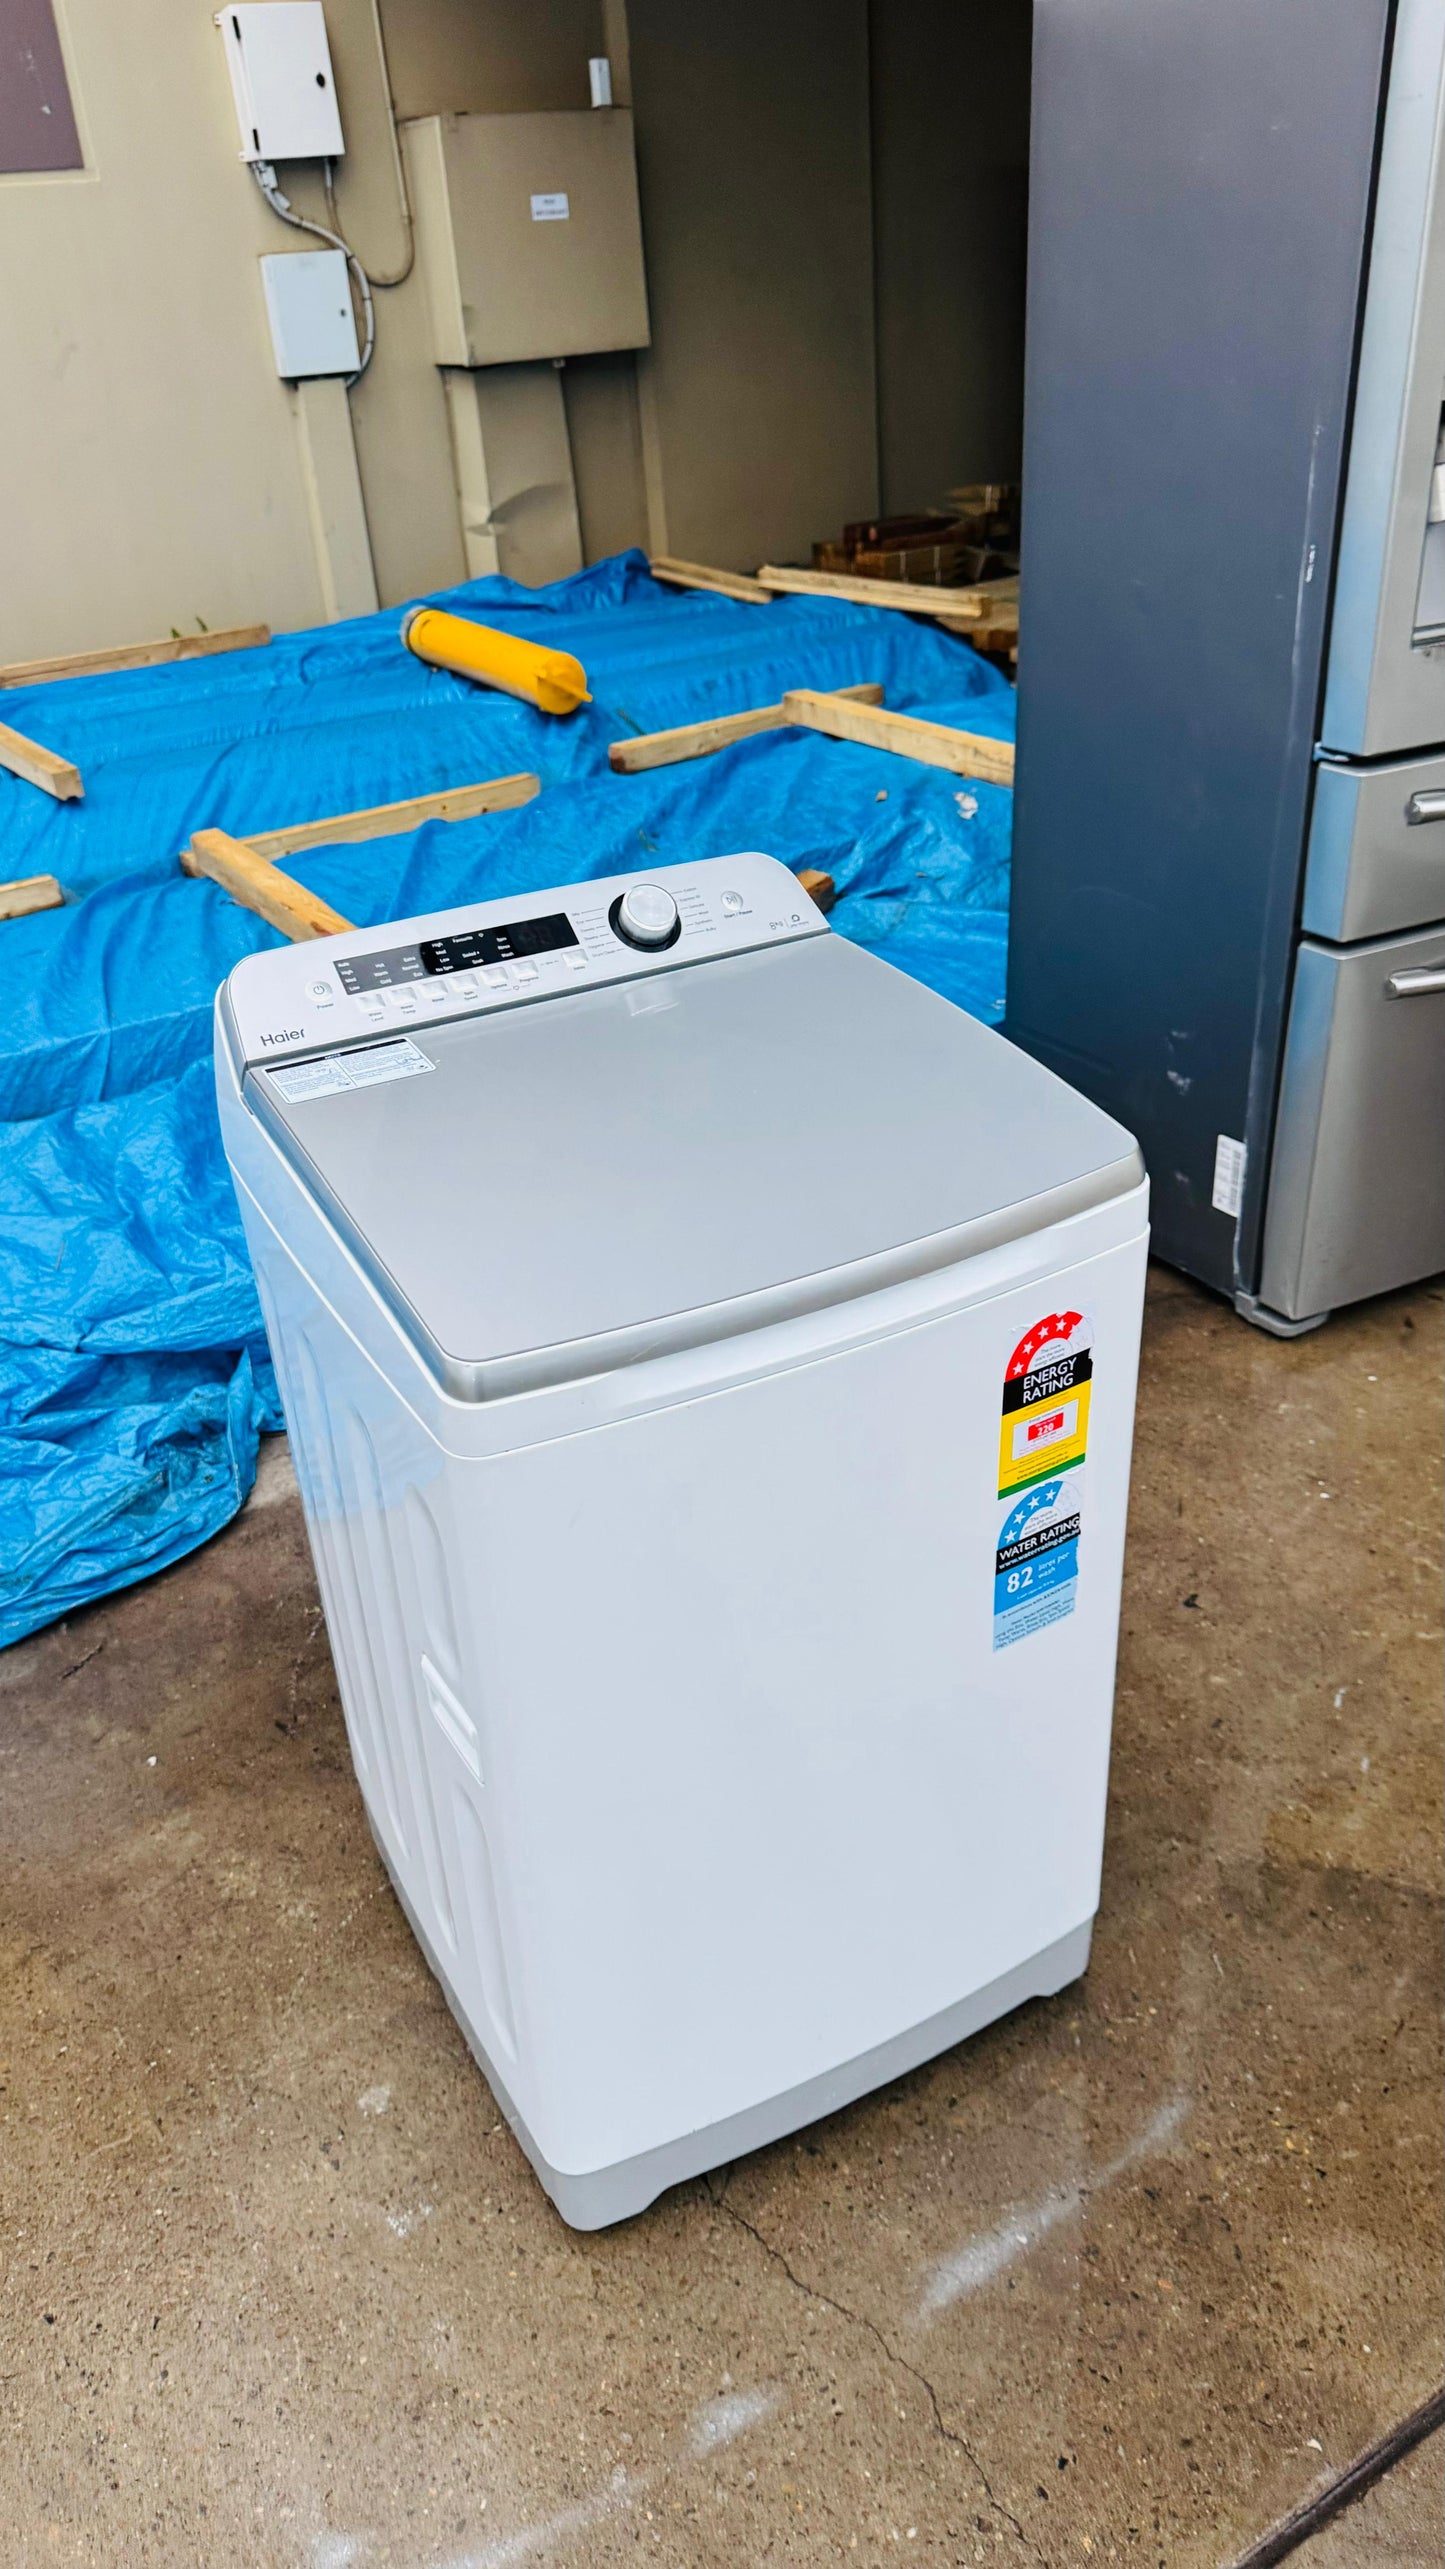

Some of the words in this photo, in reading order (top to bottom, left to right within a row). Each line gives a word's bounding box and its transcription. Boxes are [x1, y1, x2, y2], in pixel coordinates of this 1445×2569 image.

[260, 1028, 305, 1047] Haier
[1023, 1357, 1077, 1390] ENERGY
[1023, 1373, 1074, 1404] RATING
[1037, 1422, 1055, 1436] 220
[999, 1538, 1038, 1561] WATER
[1040, 1516, 1080, 1543] RATING
[1007, 1566, 1034, 1594] 82
[1057, 1552, 1070, 1564] per
[1038, 1566, 1056, 1578] wash
